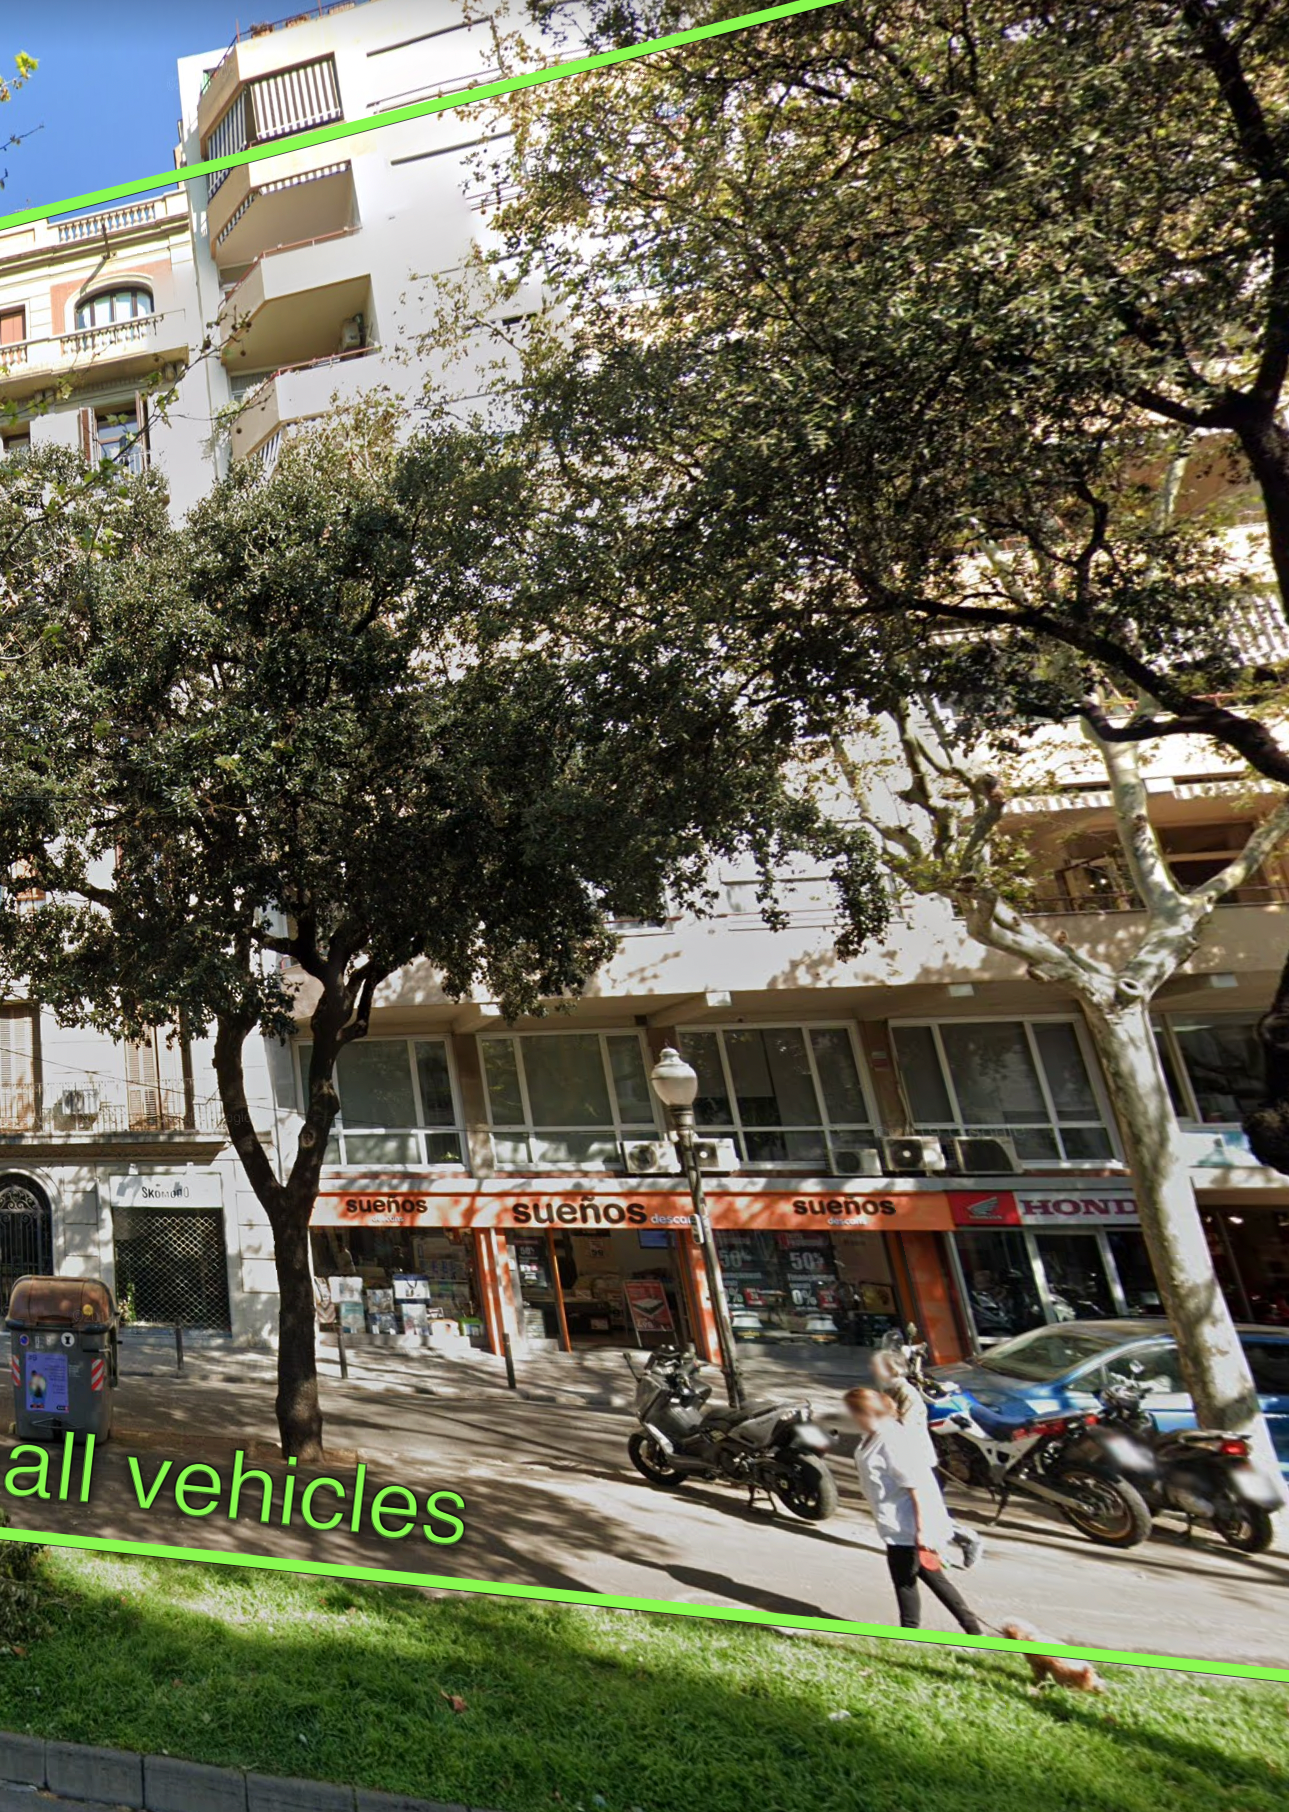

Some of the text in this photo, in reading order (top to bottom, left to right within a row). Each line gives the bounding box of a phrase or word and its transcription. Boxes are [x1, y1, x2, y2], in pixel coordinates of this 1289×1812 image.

[345, 1195, 428, 1213] sueños
[512, 1196, 647, 1224] sueños
[792, 1197, 896, 1216] sueños
[1019, 1199, 1139, 1215] HOND
